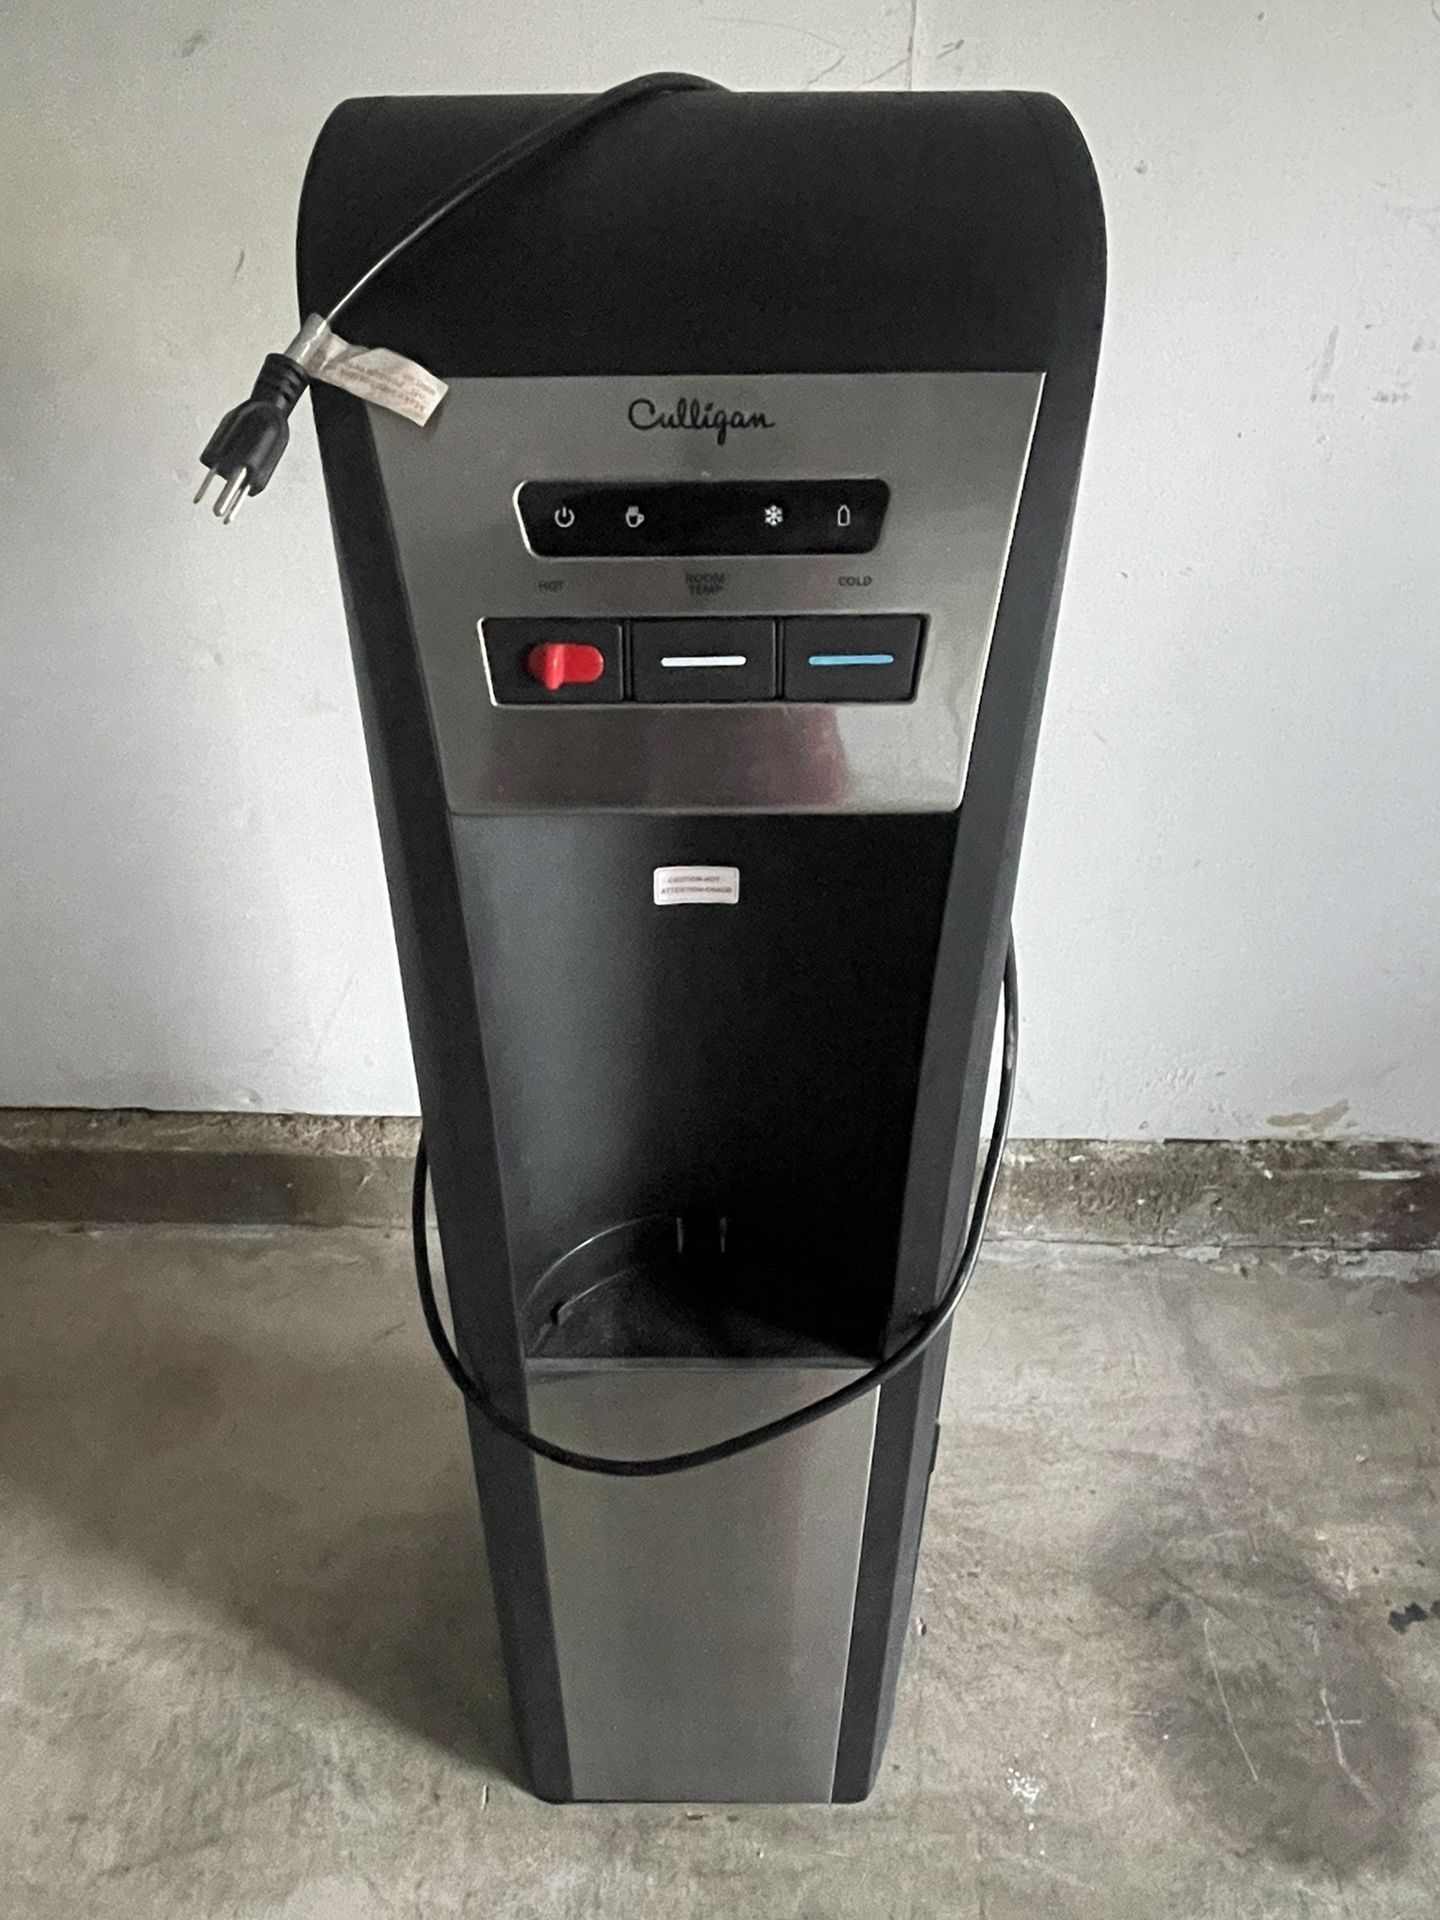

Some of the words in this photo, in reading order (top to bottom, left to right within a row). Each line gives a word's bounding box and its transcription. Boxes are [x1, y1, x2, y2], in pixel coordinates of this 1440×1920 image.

[628, 397, 775, 446] Culligan
[685, 572, 726, 584] ROOM
[837, 575, 873, 587] COLD
[538, 580, 564, 592] HOT
[688, 584, 724, 596] TEMP
